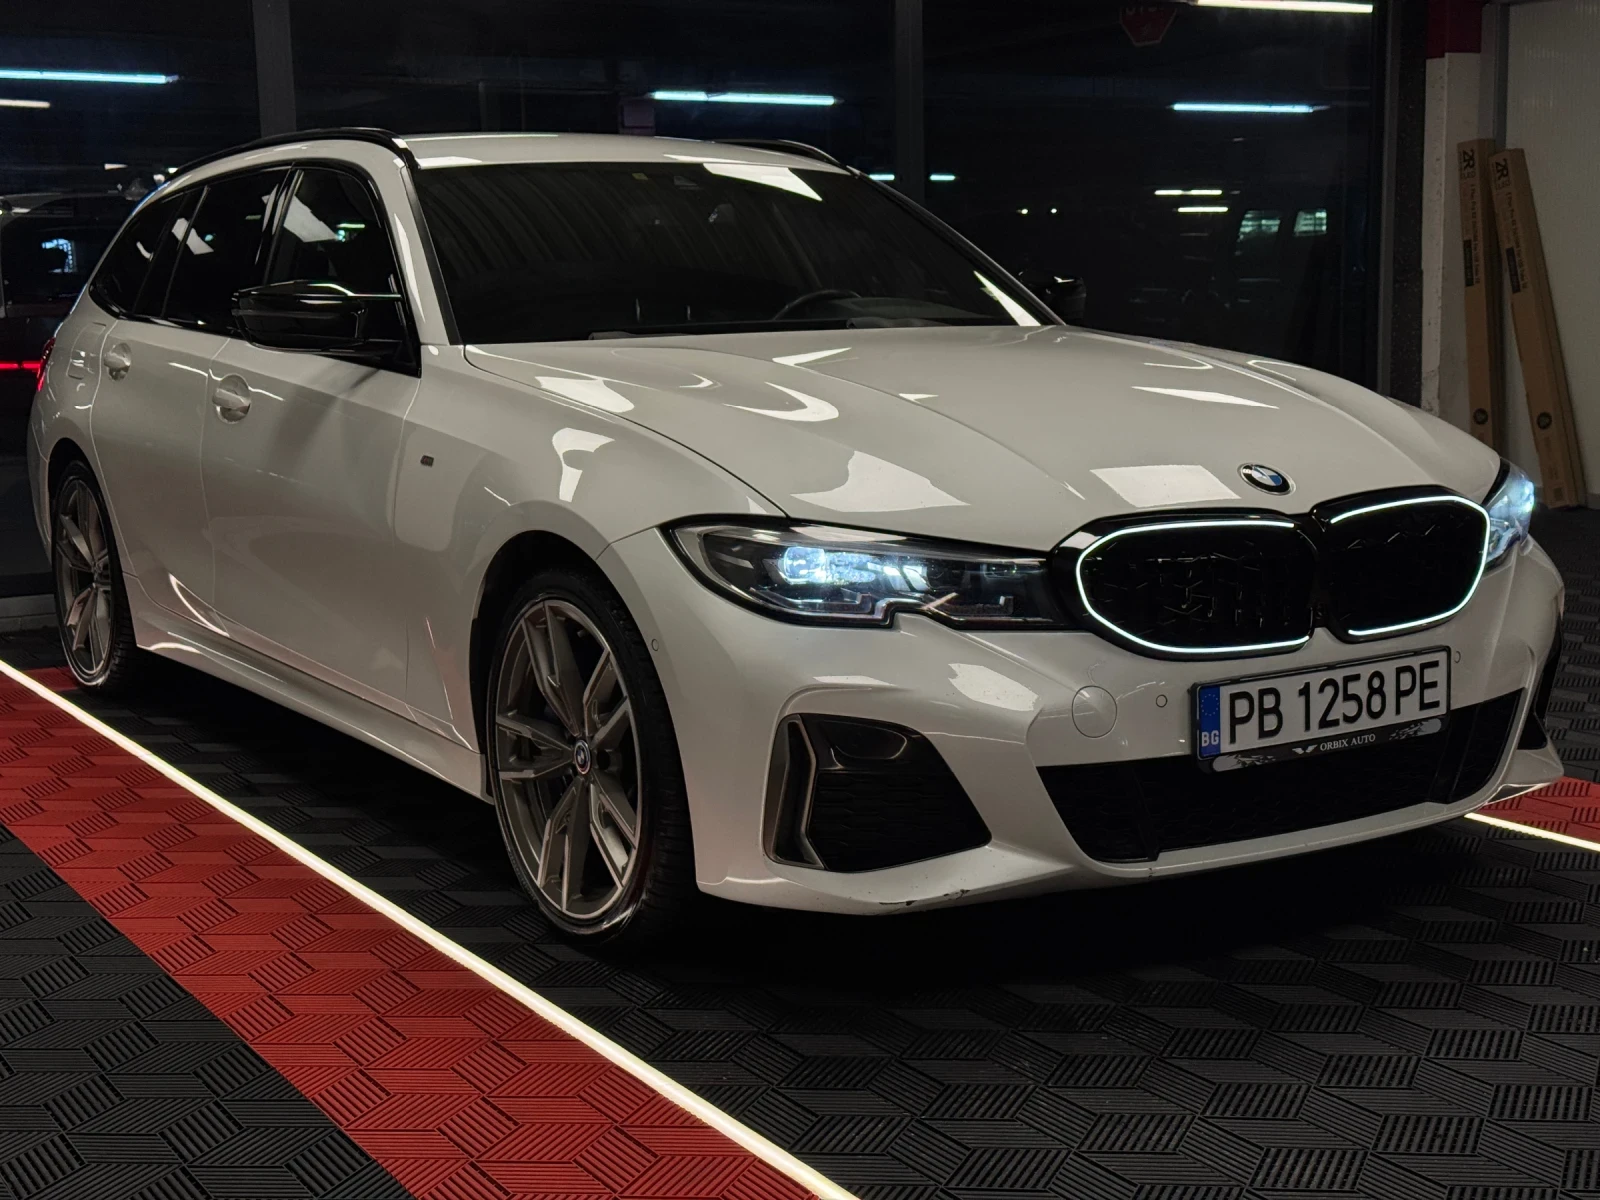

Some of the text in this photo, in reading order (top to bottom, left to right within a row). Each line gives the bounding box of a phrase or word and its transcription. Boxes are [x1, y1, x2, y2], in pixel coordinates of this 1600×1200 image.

[1229, 660, 1440, 744] PB 1258 PE
[1201, 730, 1219, 747] BG
[1320, 734, 1376, 752] ORBIX AUTO
